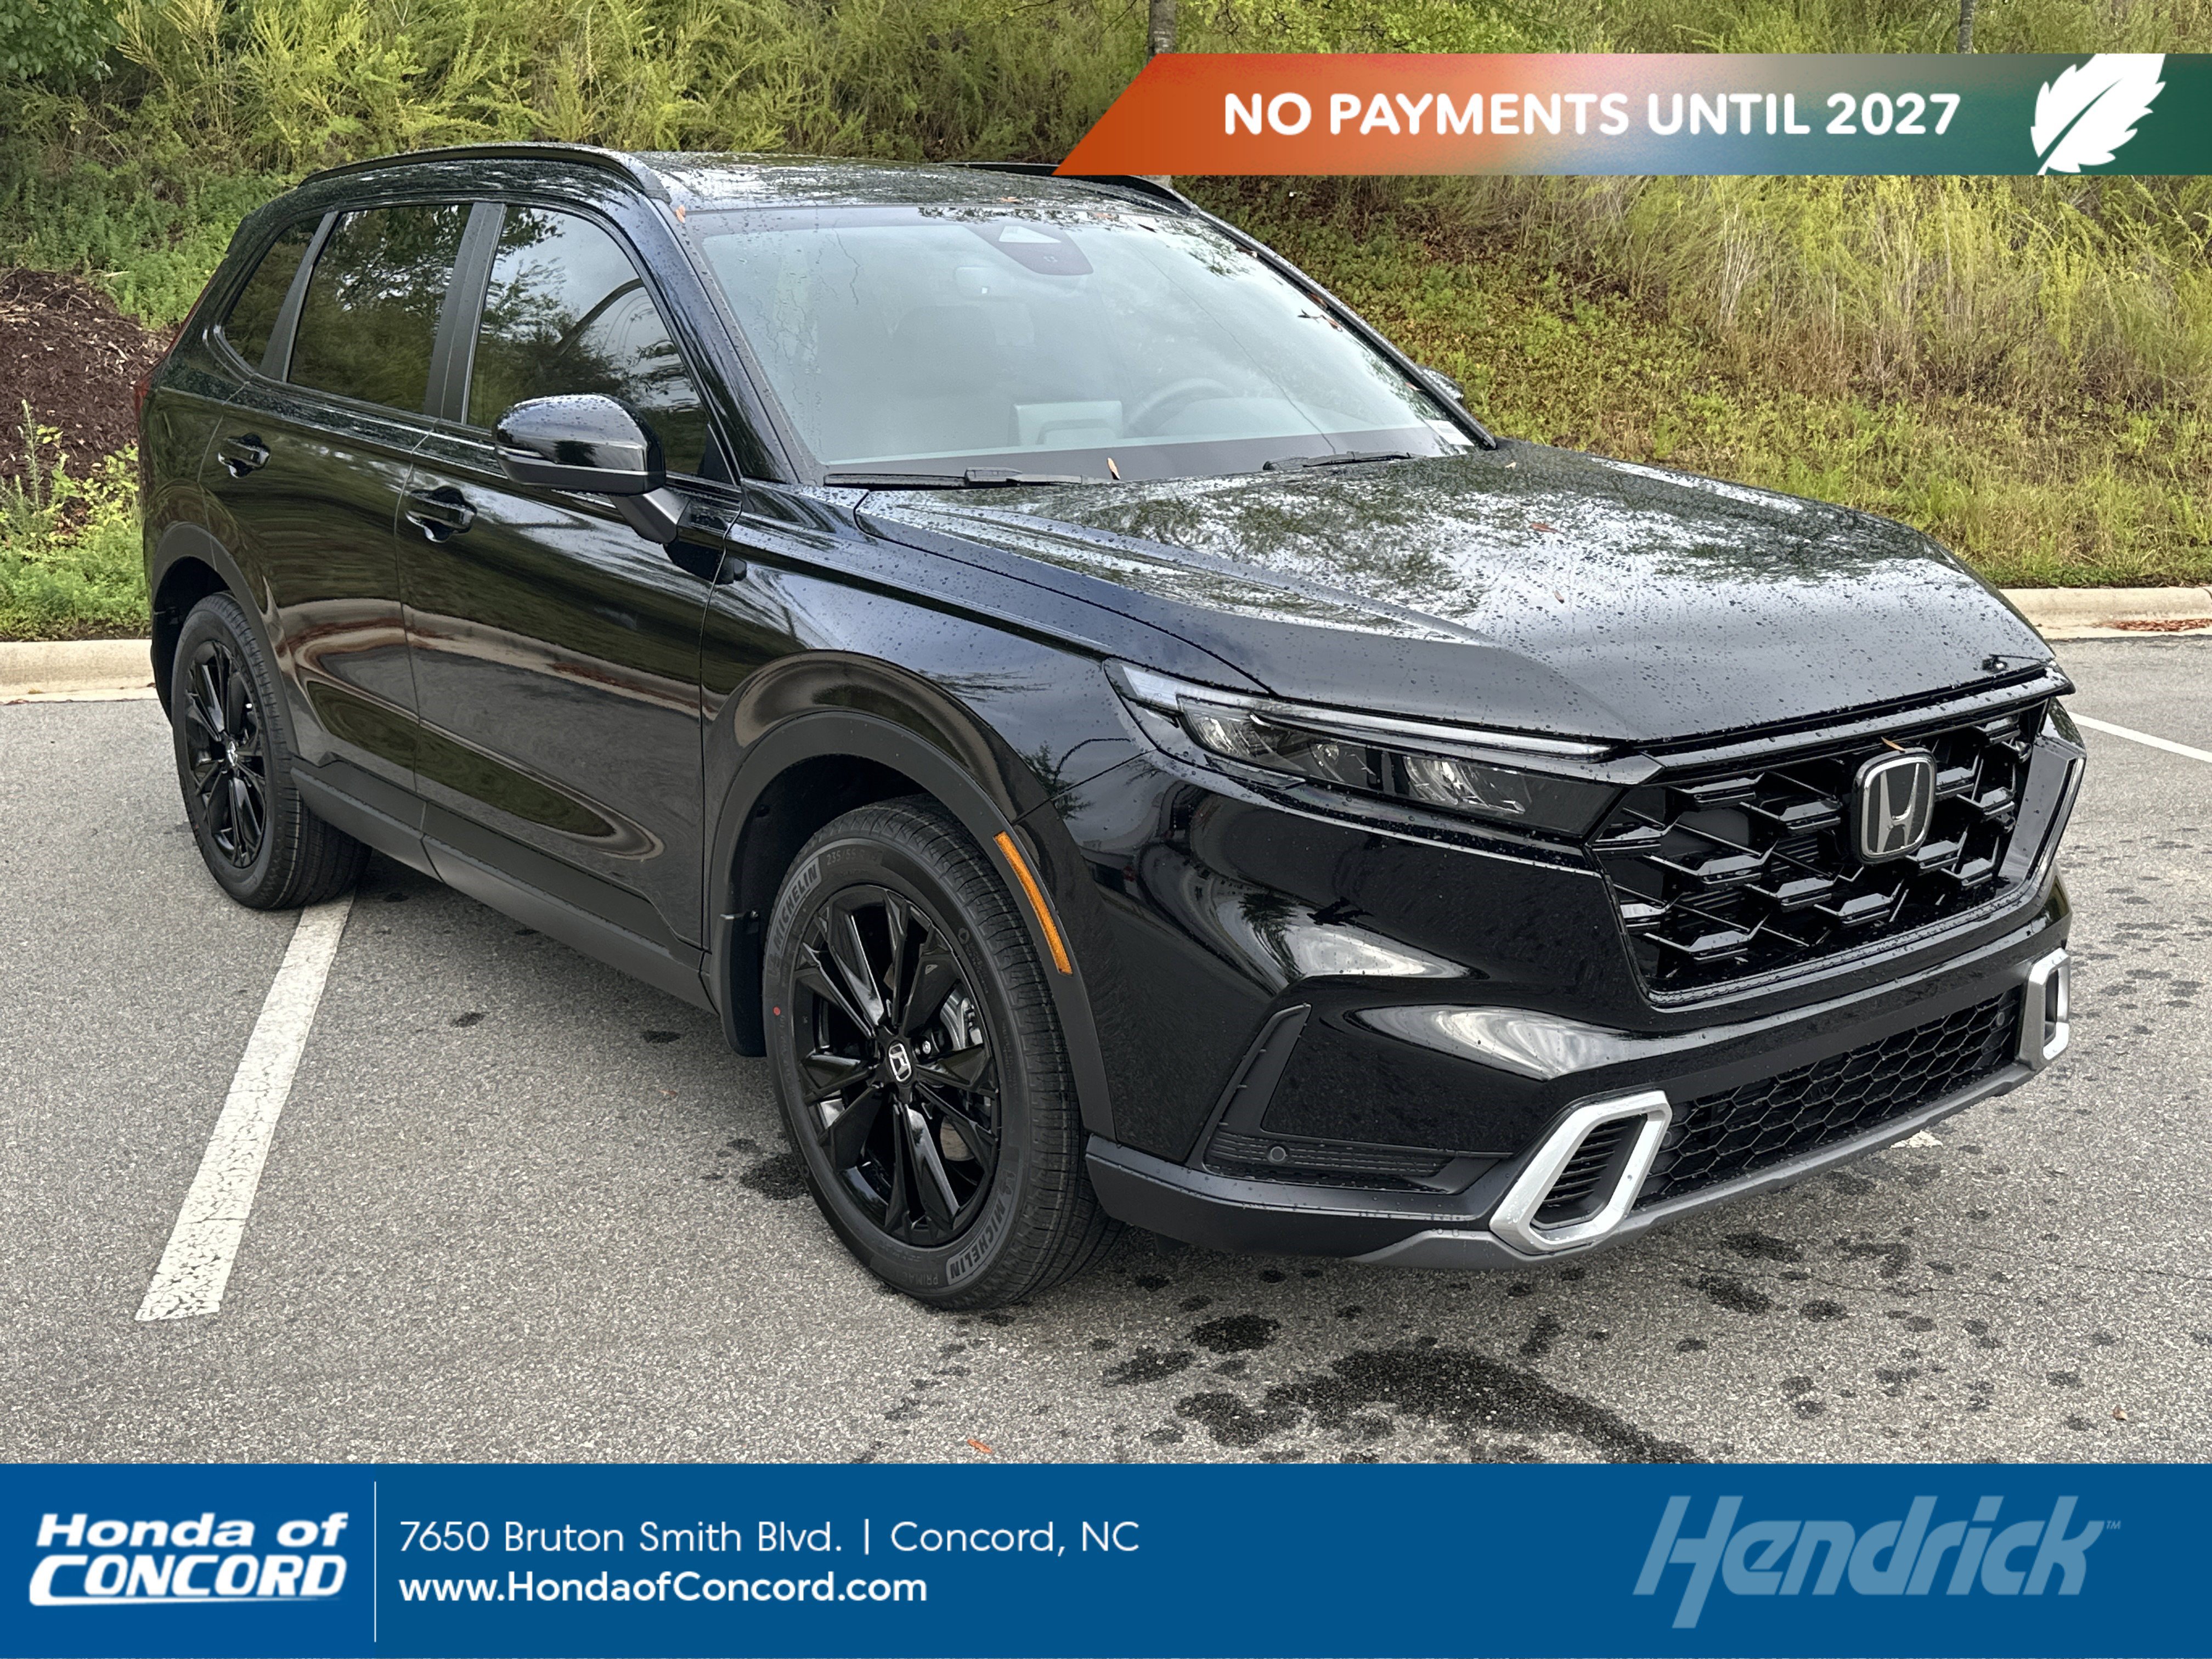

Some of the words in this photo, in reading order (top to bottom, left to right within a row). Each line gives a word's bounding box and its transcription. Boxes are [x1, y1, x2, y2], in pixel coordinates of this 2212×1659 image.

[773, 864, 818, 951] MICHELIN
[895, 1272, 939, 1286] PRIMAC
[949, 1198, 1006, 1279] MICHELIN
